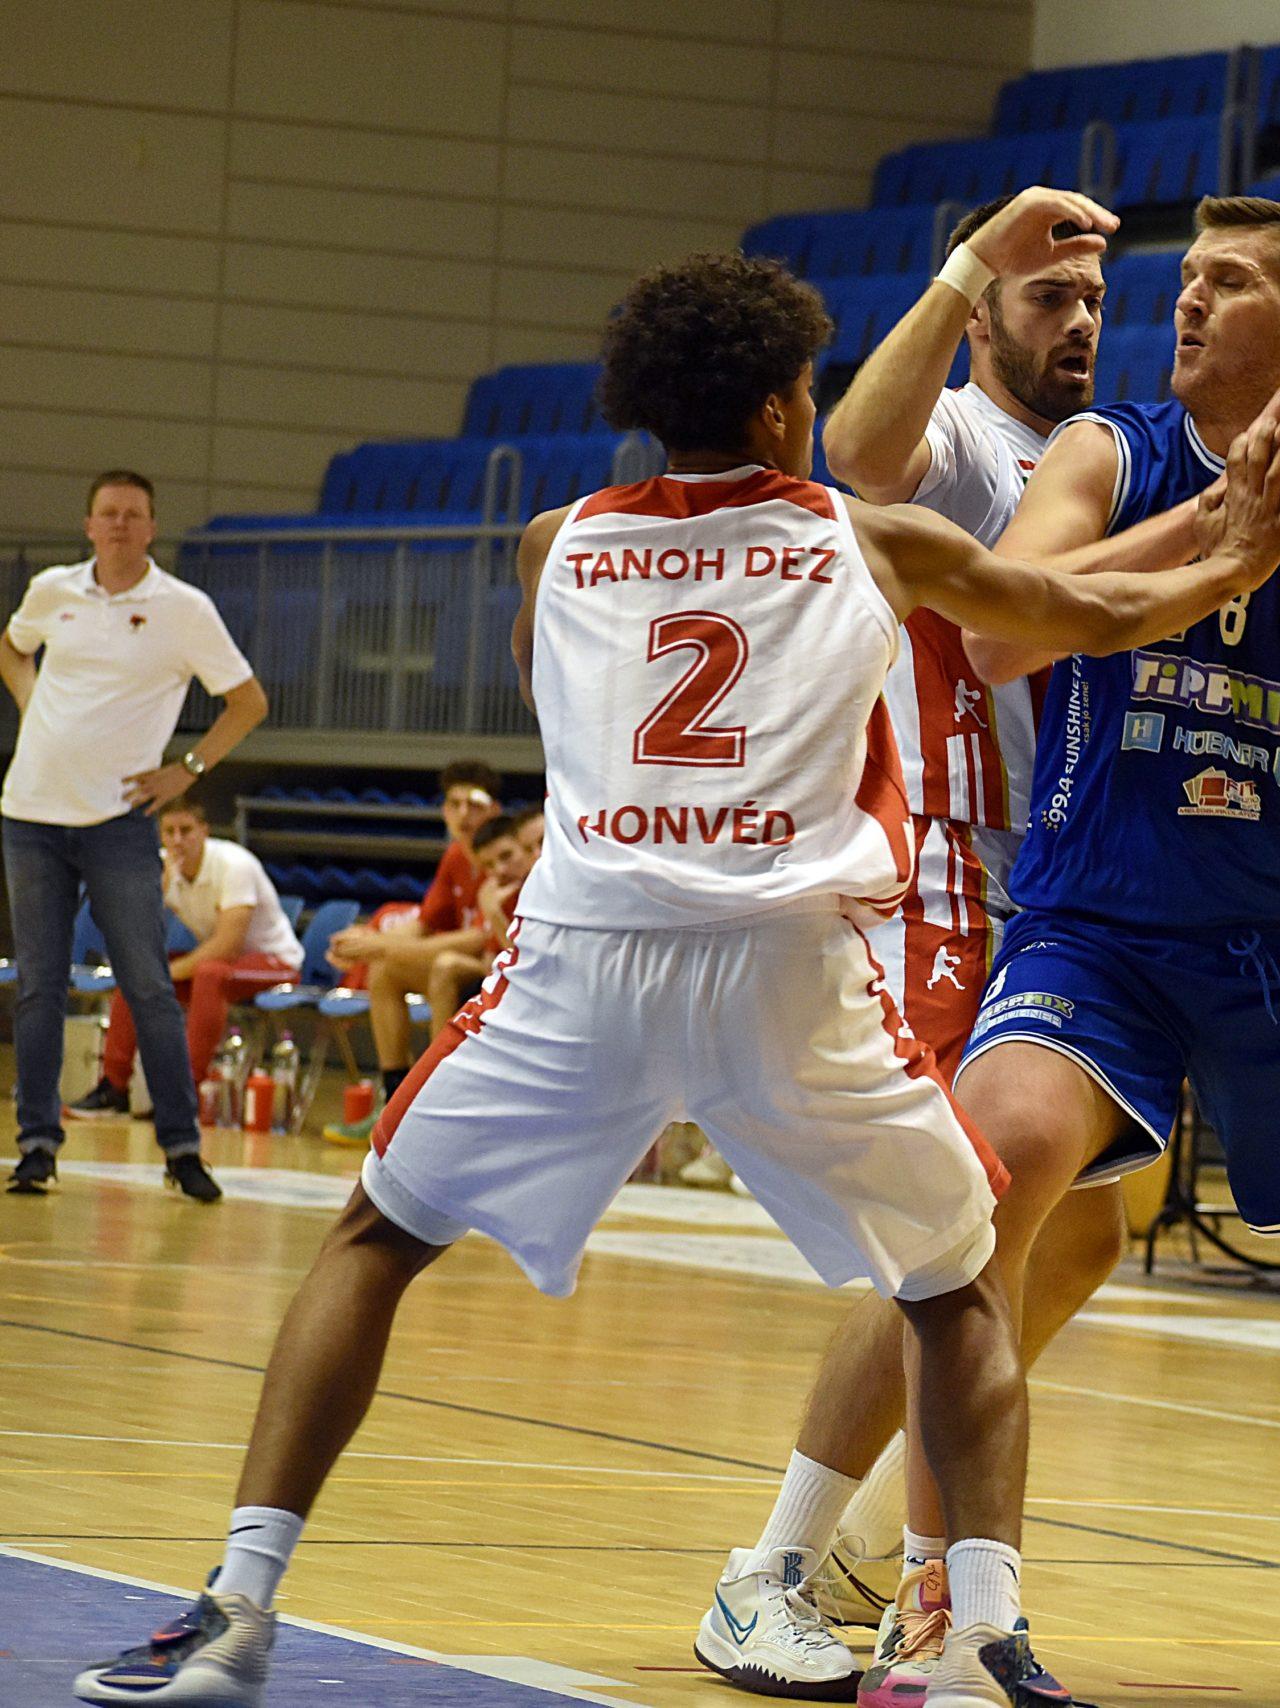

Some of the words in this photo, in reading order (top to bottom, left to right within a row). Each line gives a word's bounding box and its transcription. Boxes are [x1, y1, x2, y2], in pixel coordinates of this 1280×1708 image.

[566, 548, 725, 590] TANOH
[744, 546, 836, 584] DEZ
[633, 610, 748, 768] 2
[1048, 776, 1075, 823] 99.4
[577, 801, 797, 846] HONVÉD
